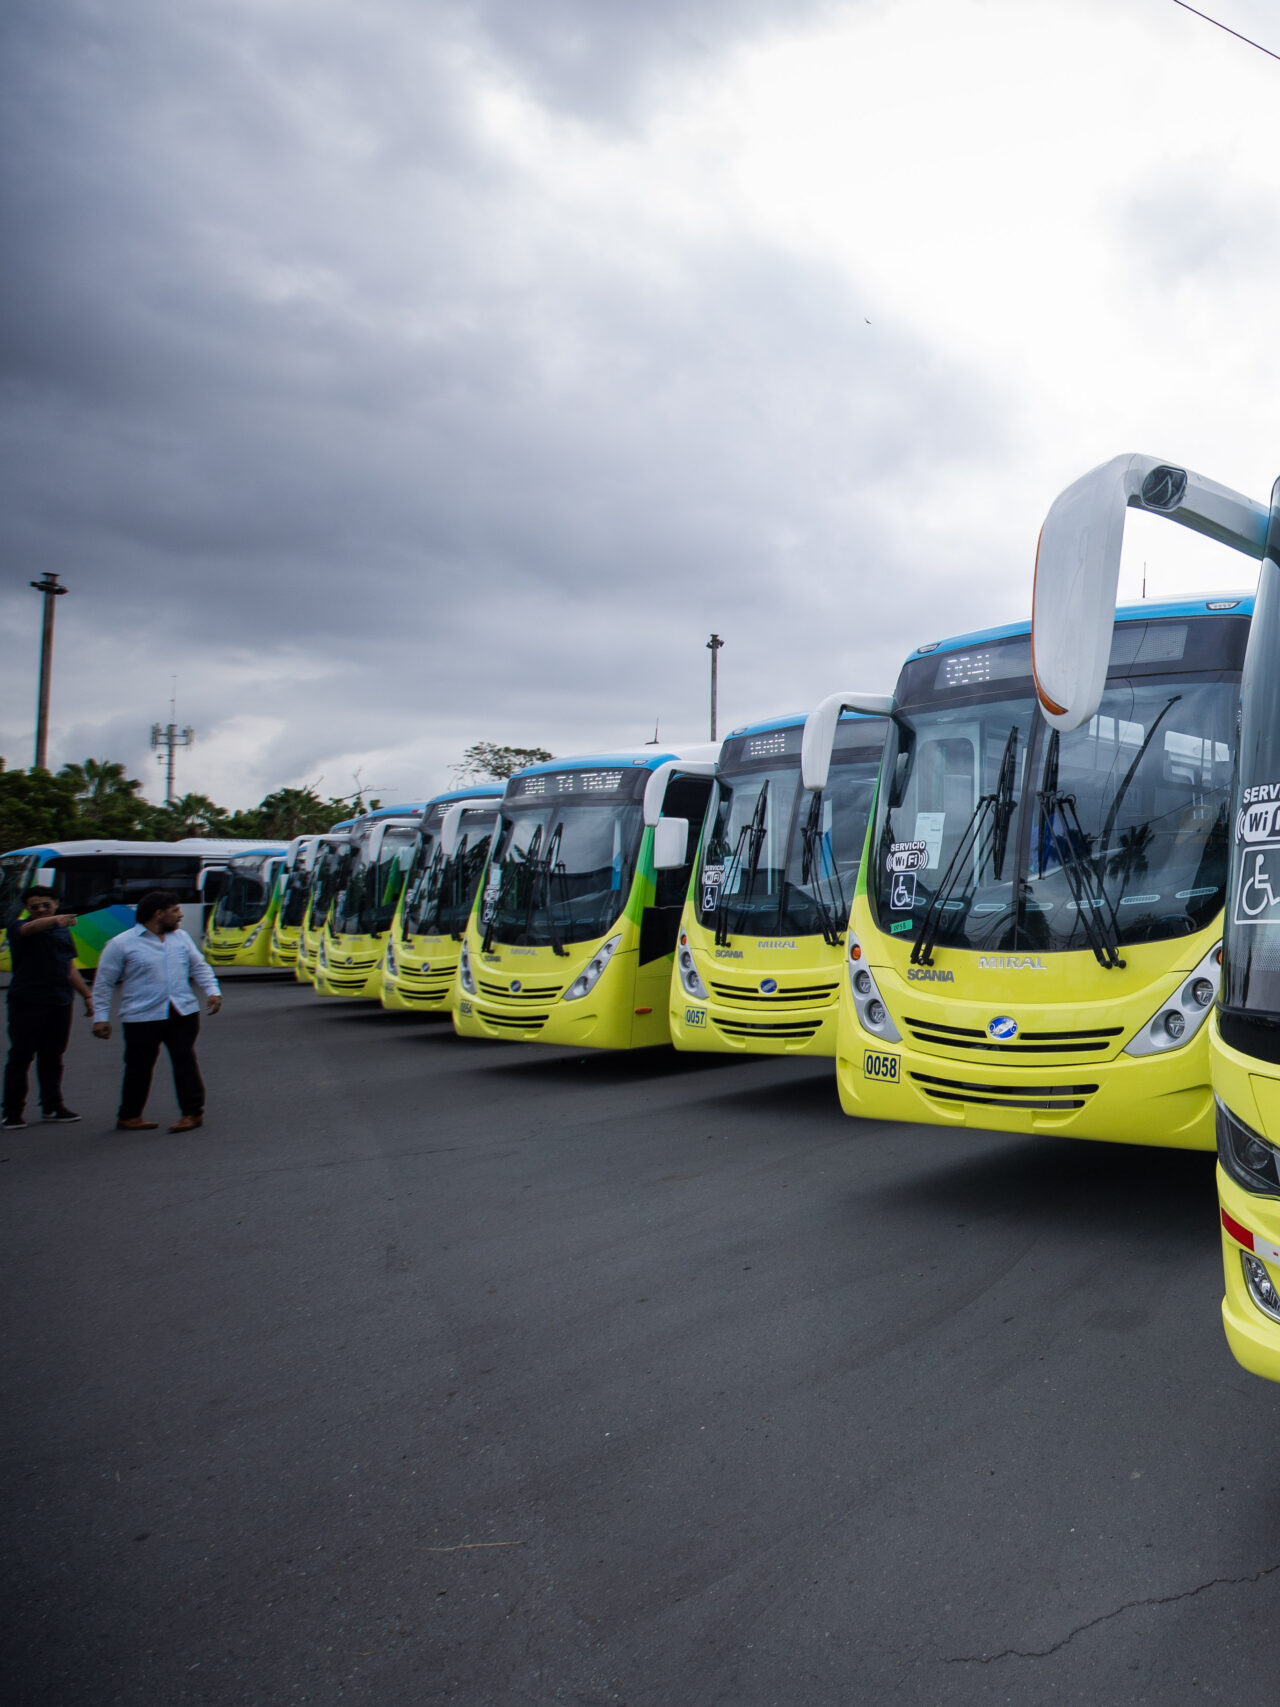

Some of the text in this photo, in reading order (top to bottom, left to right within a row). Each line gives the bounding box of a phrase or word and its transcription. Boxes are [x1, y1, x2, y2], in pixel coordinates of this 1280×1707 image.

[890, 841, 926, 852] SERVICIO
[757, 941, 799, 950] MIRAL
[715, 949, 744, 959] SCANIA
[978, 956, 1048, 970] MIRAL
[907, 968, 955, 983] SCANIA
[686, 1009, 705, 1025] 0057
[866, 1054, 898, 1079] 0058
